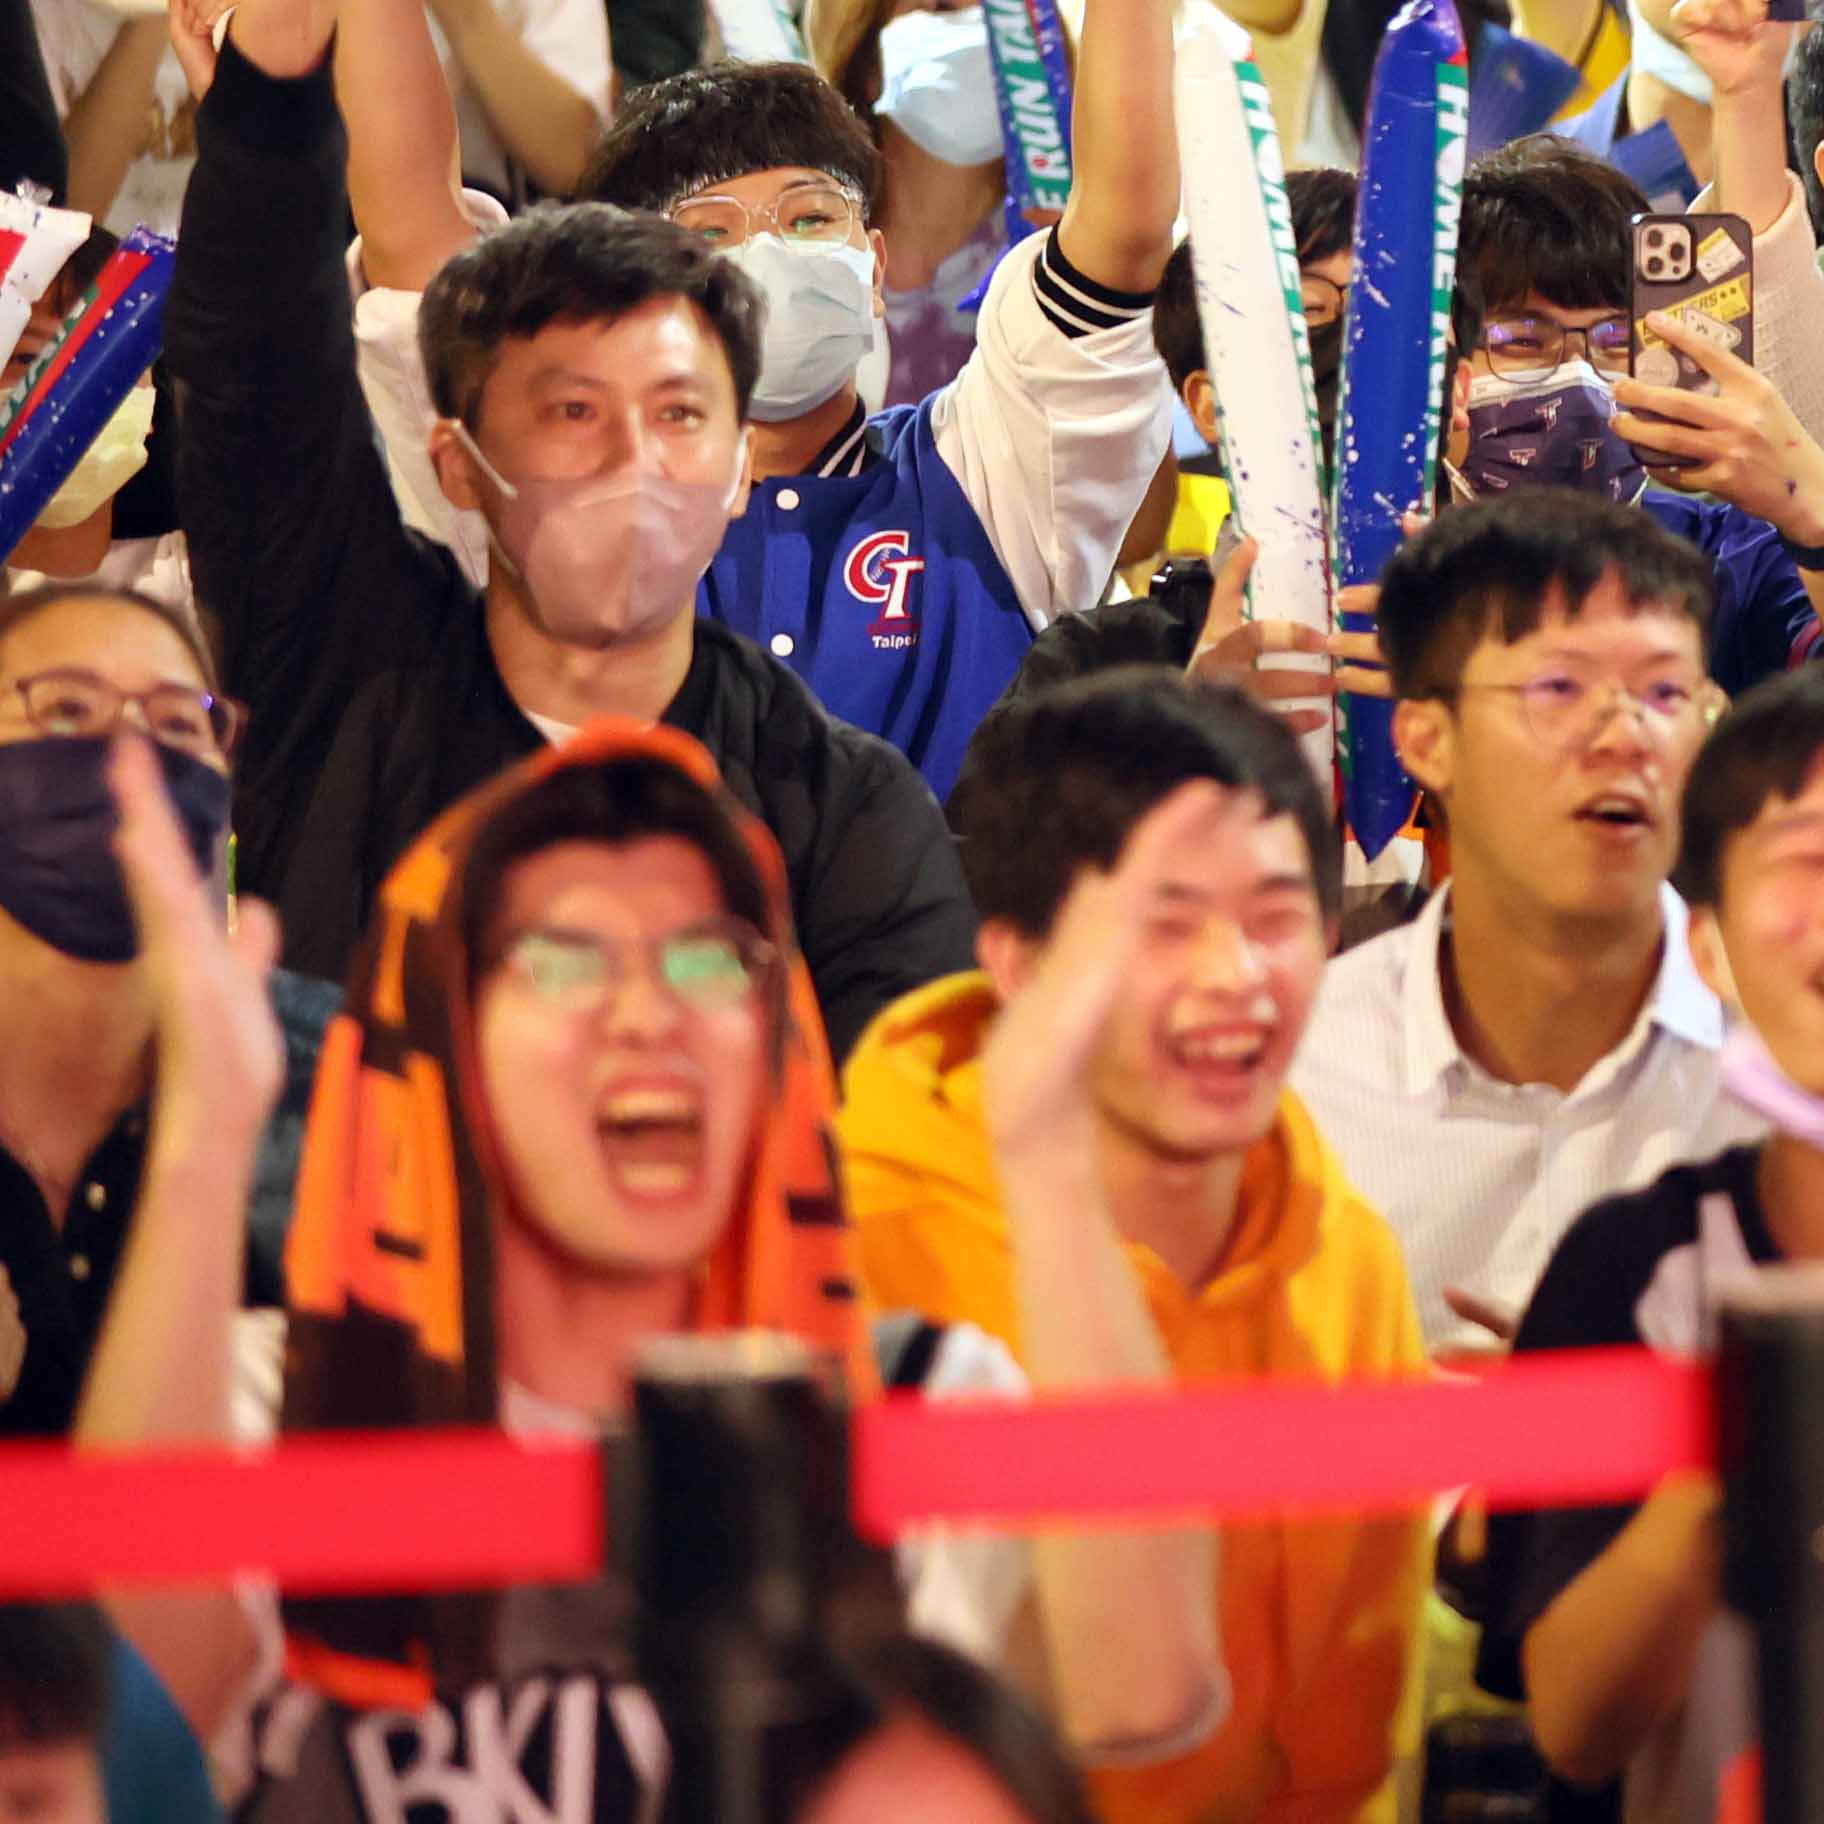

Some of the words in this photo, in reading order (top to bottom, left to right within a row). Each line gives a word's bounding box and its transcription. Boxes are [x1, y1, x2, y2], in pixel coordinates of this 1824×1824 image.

[1008, 79, 1072, 182] RUN
[1237, 79, 1302, 290] HOME
[1436, 82, 1468, 288] HOME
[871, 633, 918, 651] Taipei
